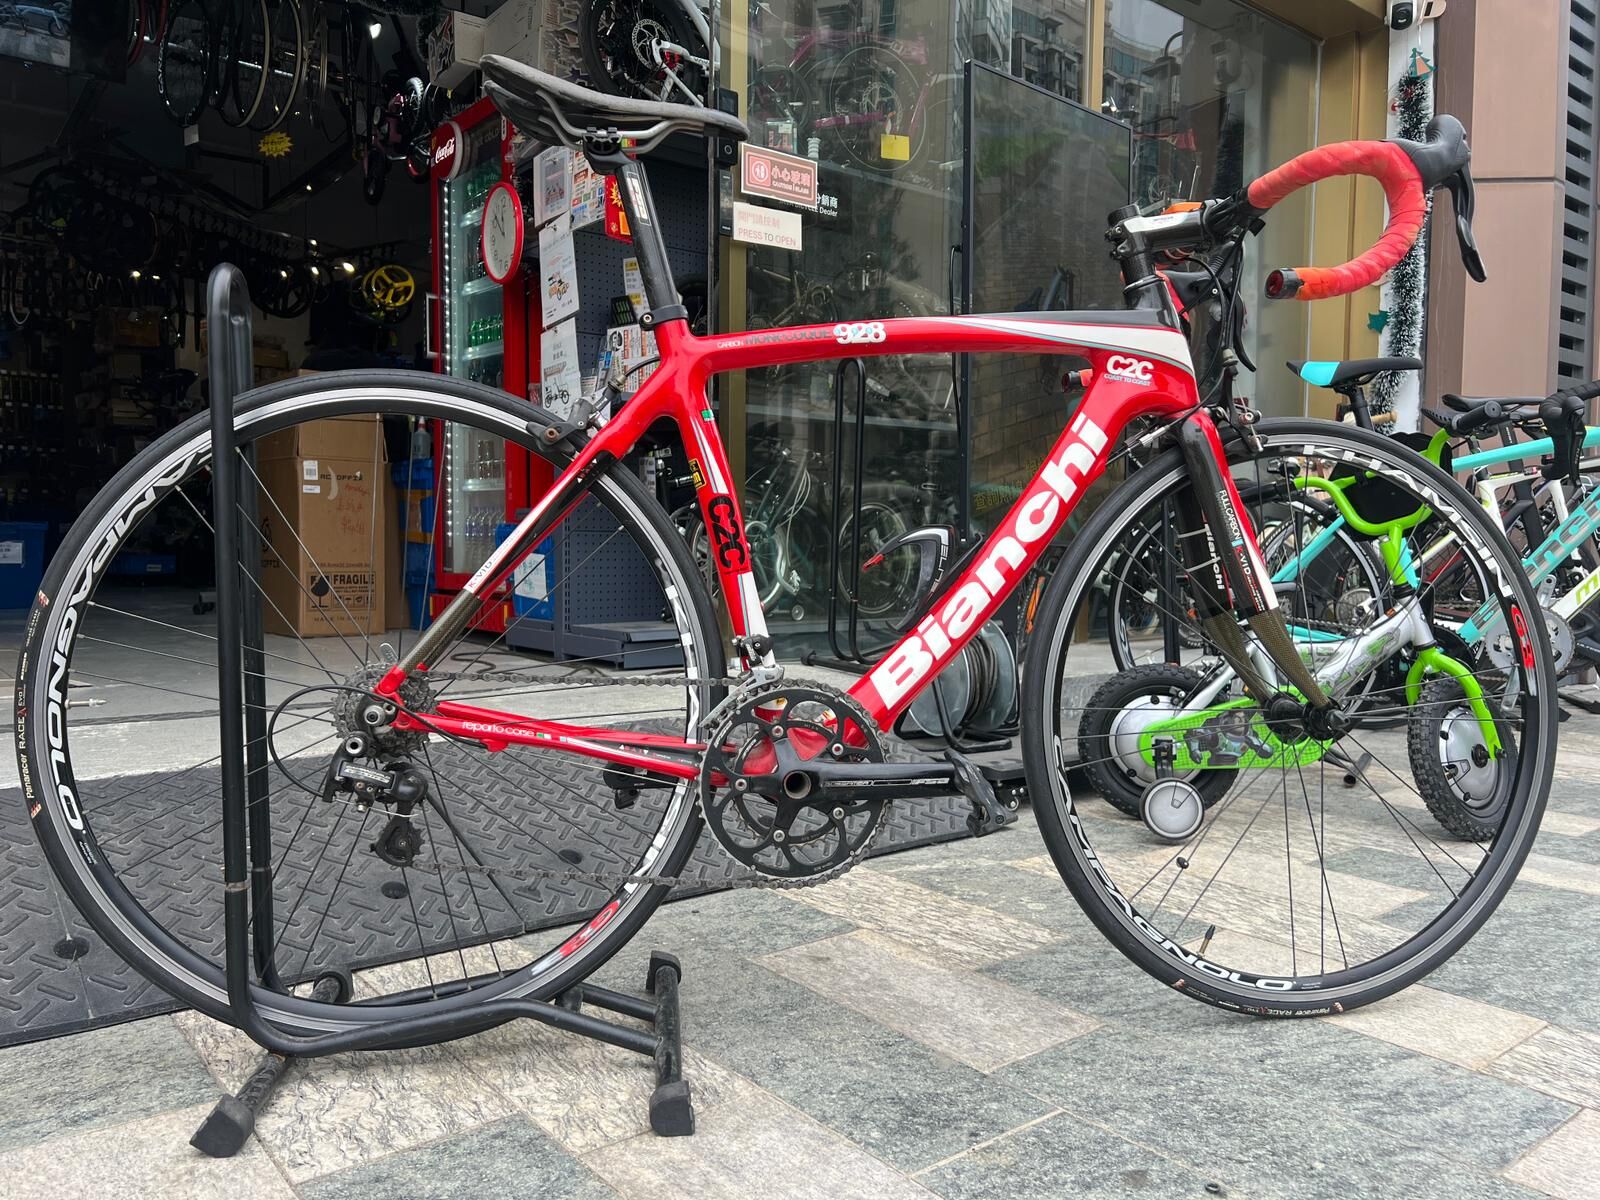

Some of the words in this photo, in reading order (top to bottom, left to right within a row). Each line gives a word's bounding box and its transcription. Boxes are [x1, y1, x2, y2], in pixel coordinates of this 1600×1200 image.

[819, 206, 838, 217] Dealer
[738, 227, 763, 240] PRESS
[764, 232, 774, 242] TO
[775, 235, 796, 247] OPEN
[833, 322, 887, 345] 928
[1106, 355, 1154, 381] C2C
[707, 495, 748, 569] C2C
[869, 412, 1109, 711] Bianchi
[1236, 545, 1252, 575] K-VID
[333, 574, 374, 585] FRAGILE
[1510, 603, 1536, 670] G3
[17, 716, 27, 749] RACE
[461, 720, 504, 735] reparto
[504, 725, 535, 737] corse
[624, 585, 700, 894] KHASIN
[19, 753, 35, 799] Panaracer
[1054, 735, 1293, 991] CAMPAGNOLO
[1294, 1006, 1330, 1015] Panaracer
